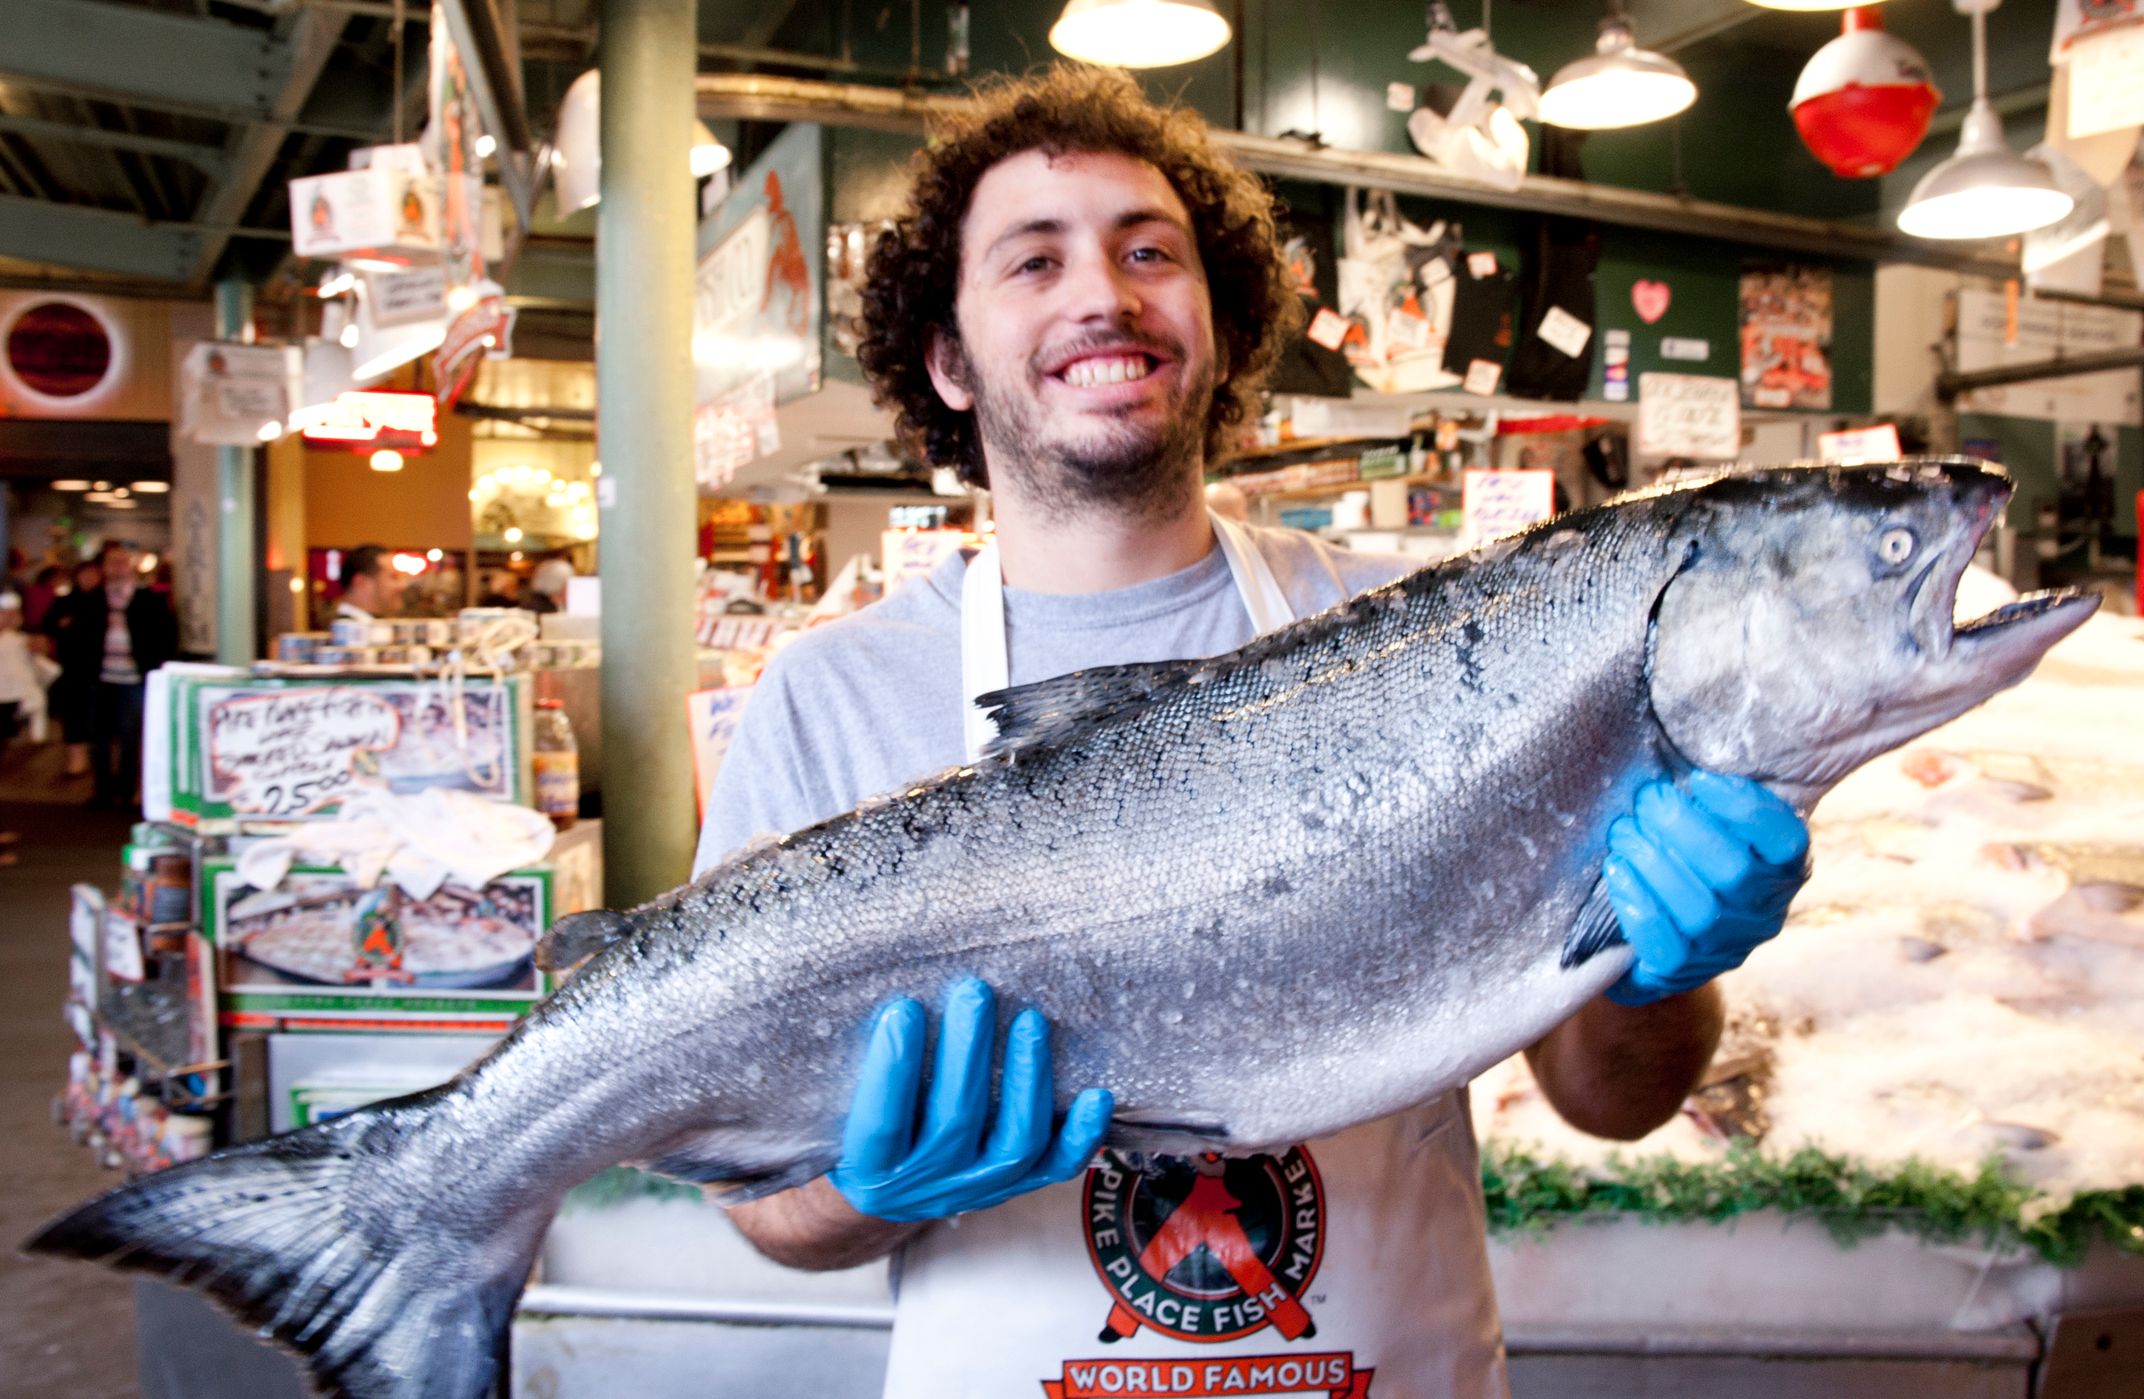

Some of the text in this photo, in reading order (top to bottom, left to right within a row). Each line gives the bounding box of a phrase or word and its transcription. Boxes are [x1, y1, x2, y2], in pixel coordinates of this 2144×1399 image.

[1093, 1153, 1316, 1332] PIKE PLACE FISH MARKE
[1068, 1357, 1346, 1393] WORLD FAMOUS
